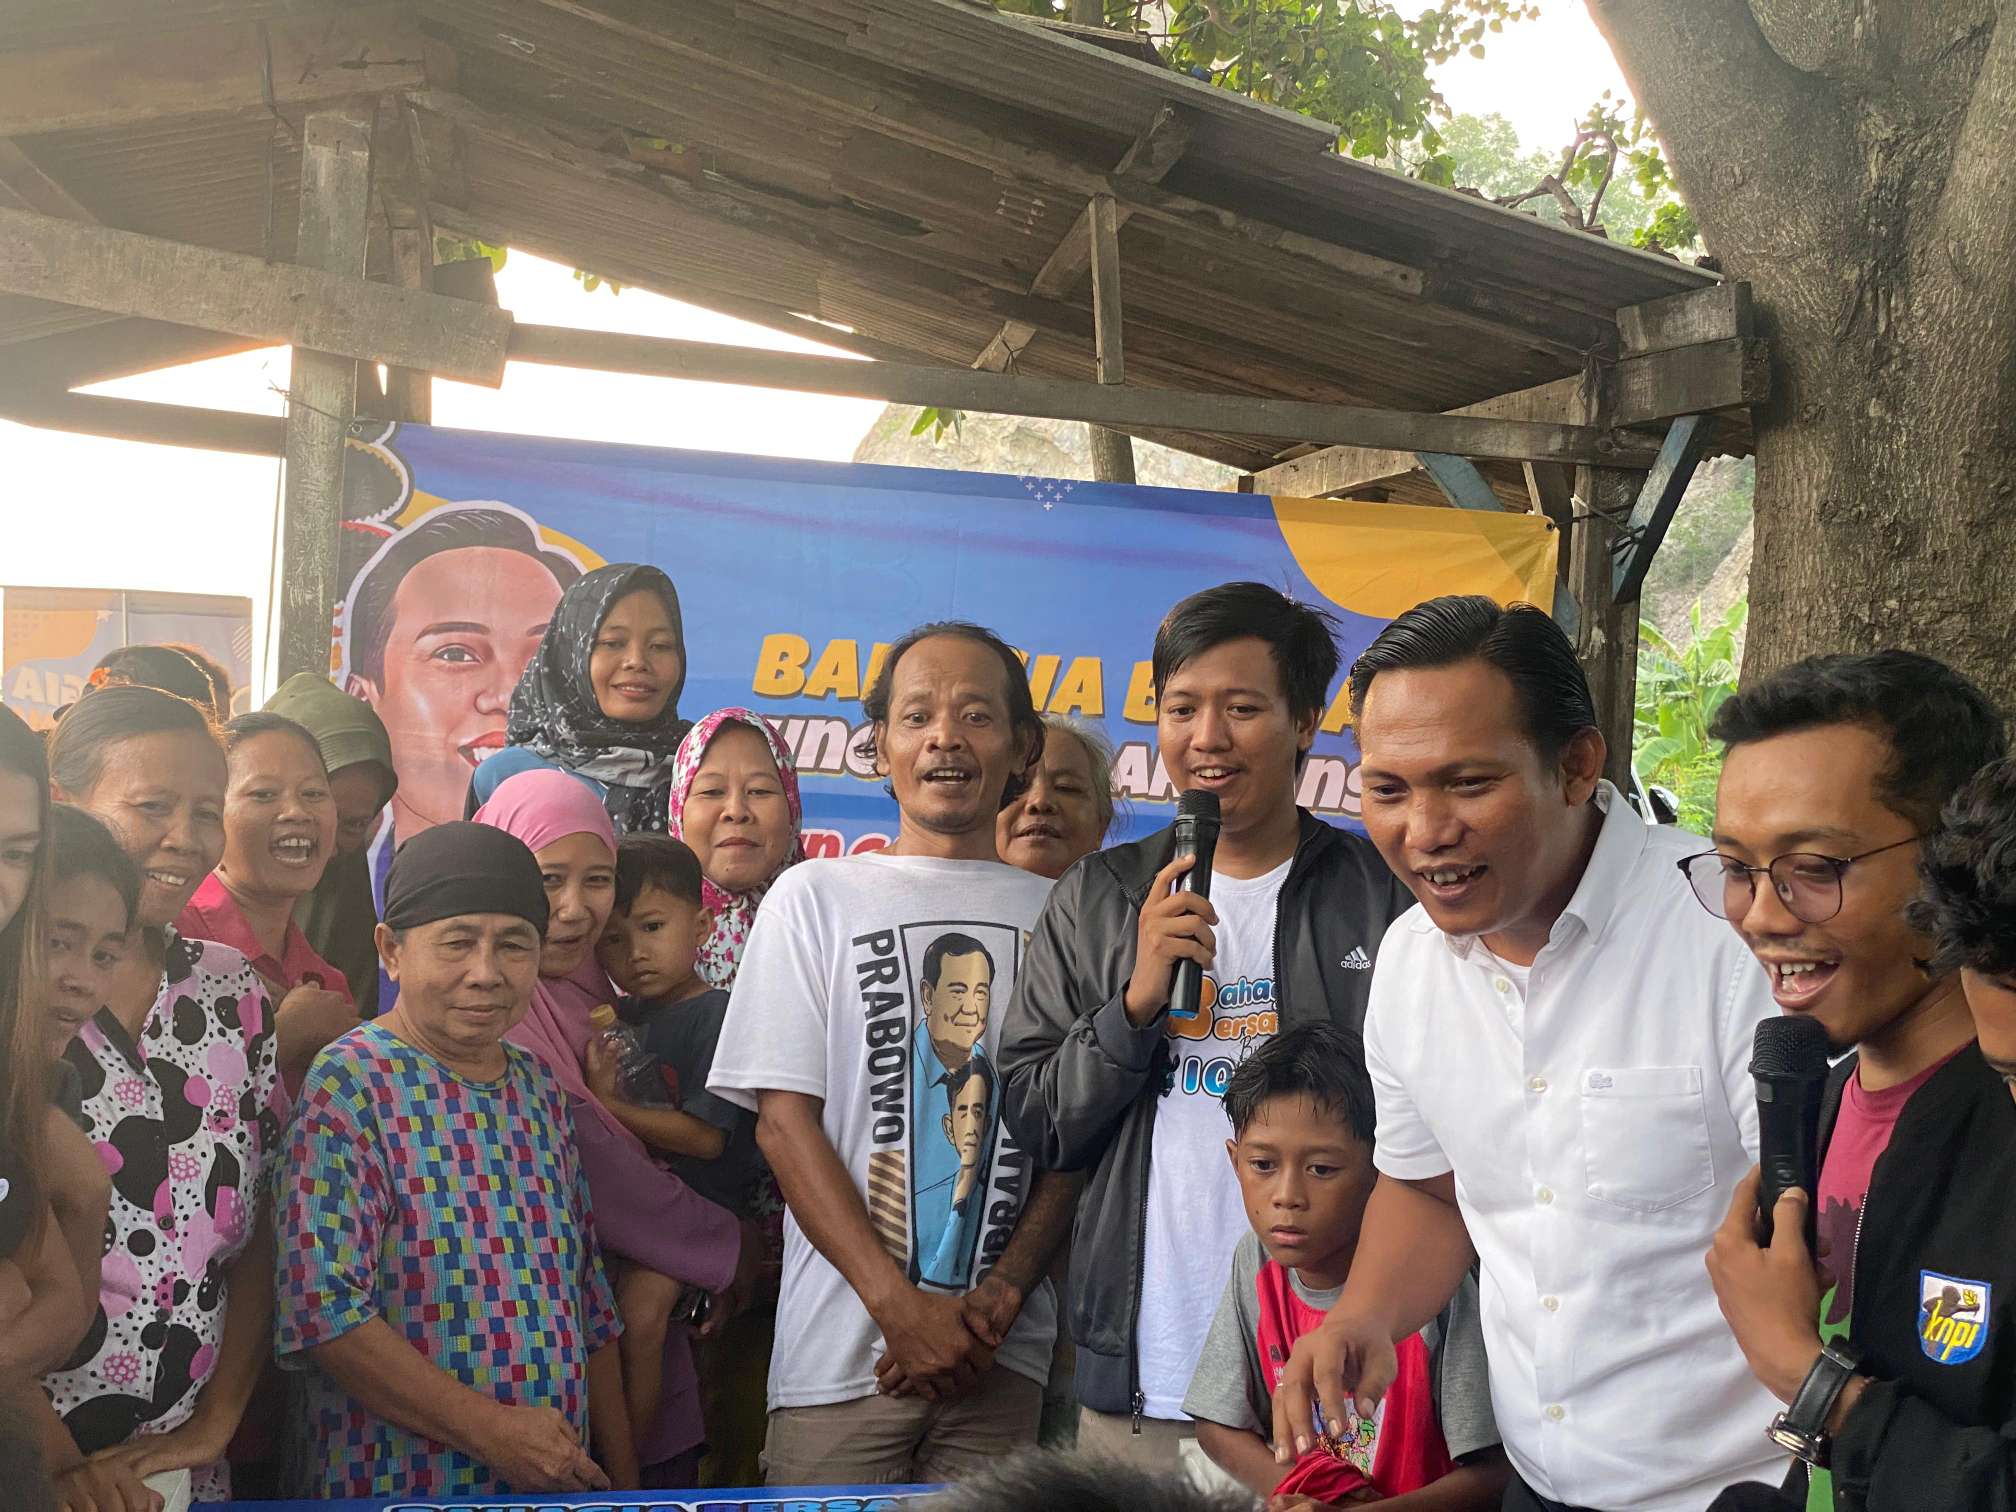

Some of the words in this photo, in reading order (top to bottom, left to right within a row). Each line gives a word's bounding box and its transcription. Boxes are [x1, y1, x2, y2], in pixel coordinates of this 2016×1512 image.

[1341, 960, 1371, 970] adidas
[852, 928, 906, 1145] PRABOWO
[1924, 1300, 1980, 1360] knpi
